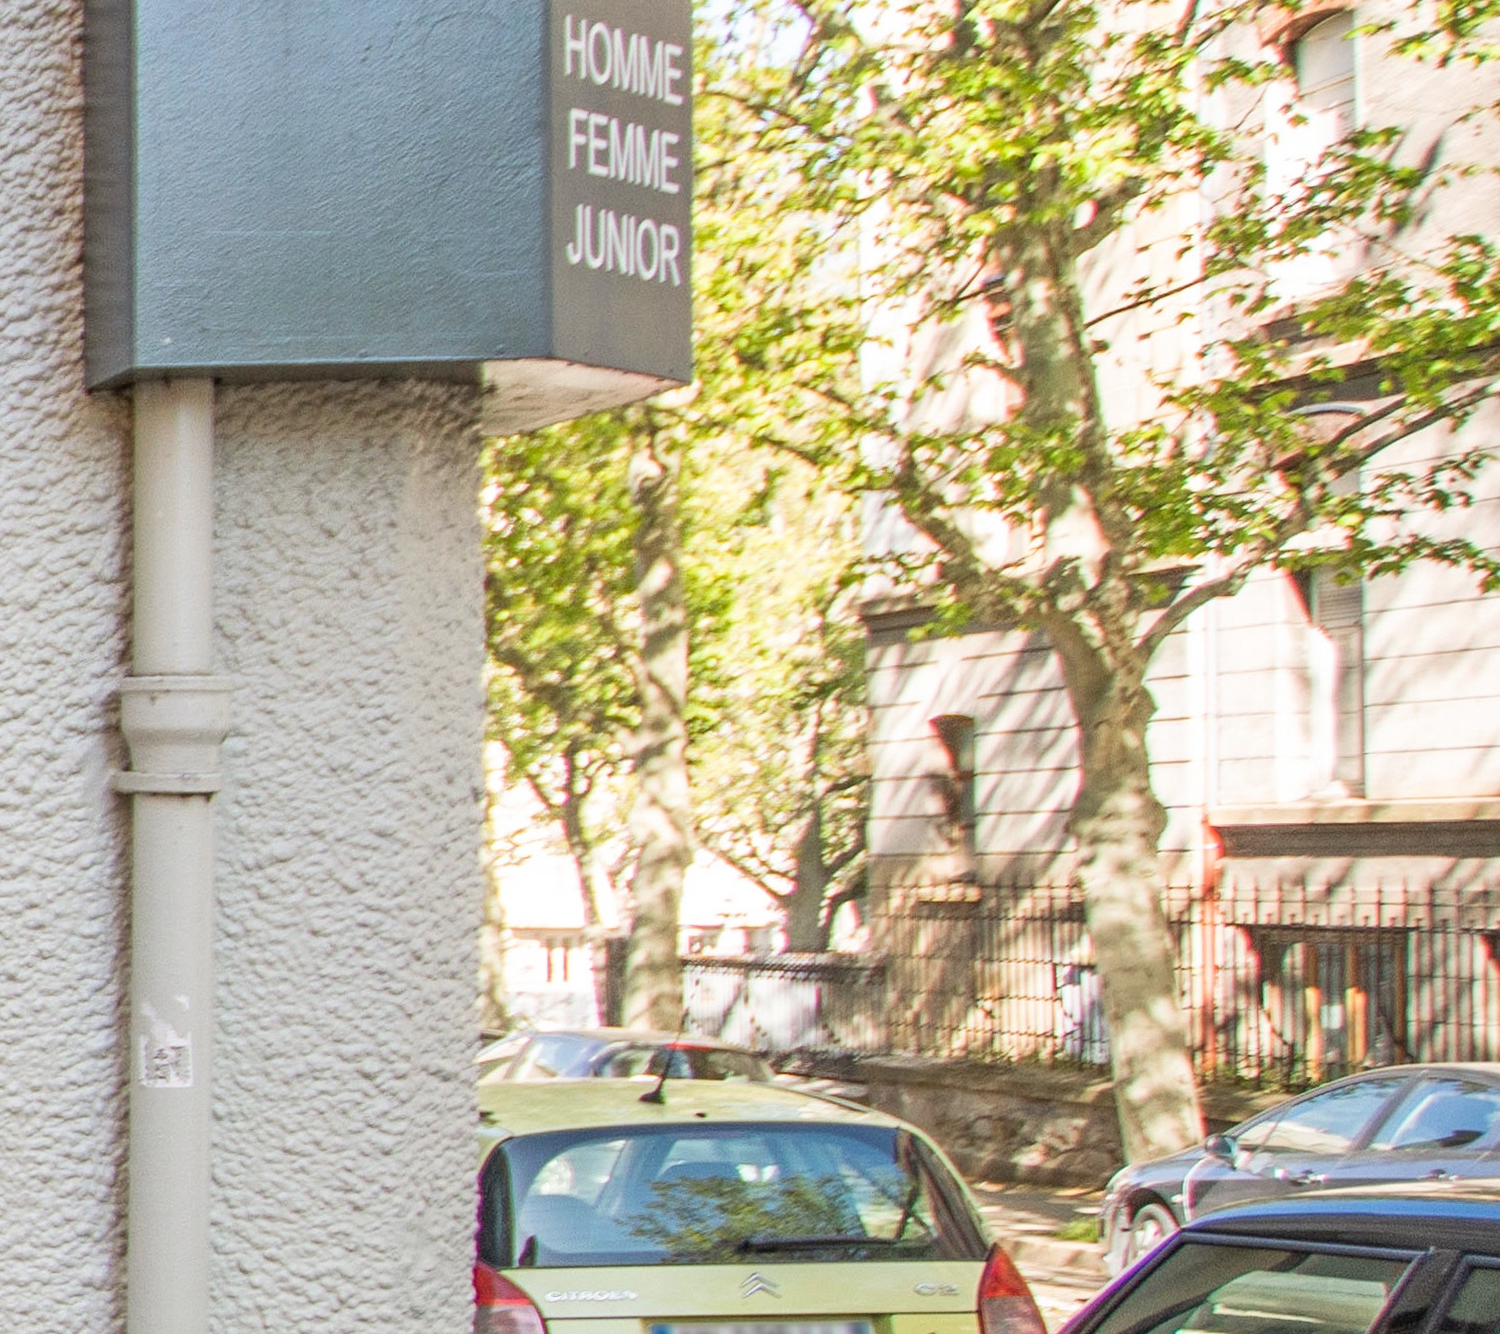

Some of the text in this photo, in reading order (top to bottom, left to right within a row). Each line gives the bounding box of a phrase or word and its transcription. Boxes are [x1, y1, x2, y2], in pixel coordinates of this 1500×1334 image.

[564, 14, 685, 107] HOMME
[567, 108, 681, 195] FEMME
[566, 204, 682, 287] JUNIOR
